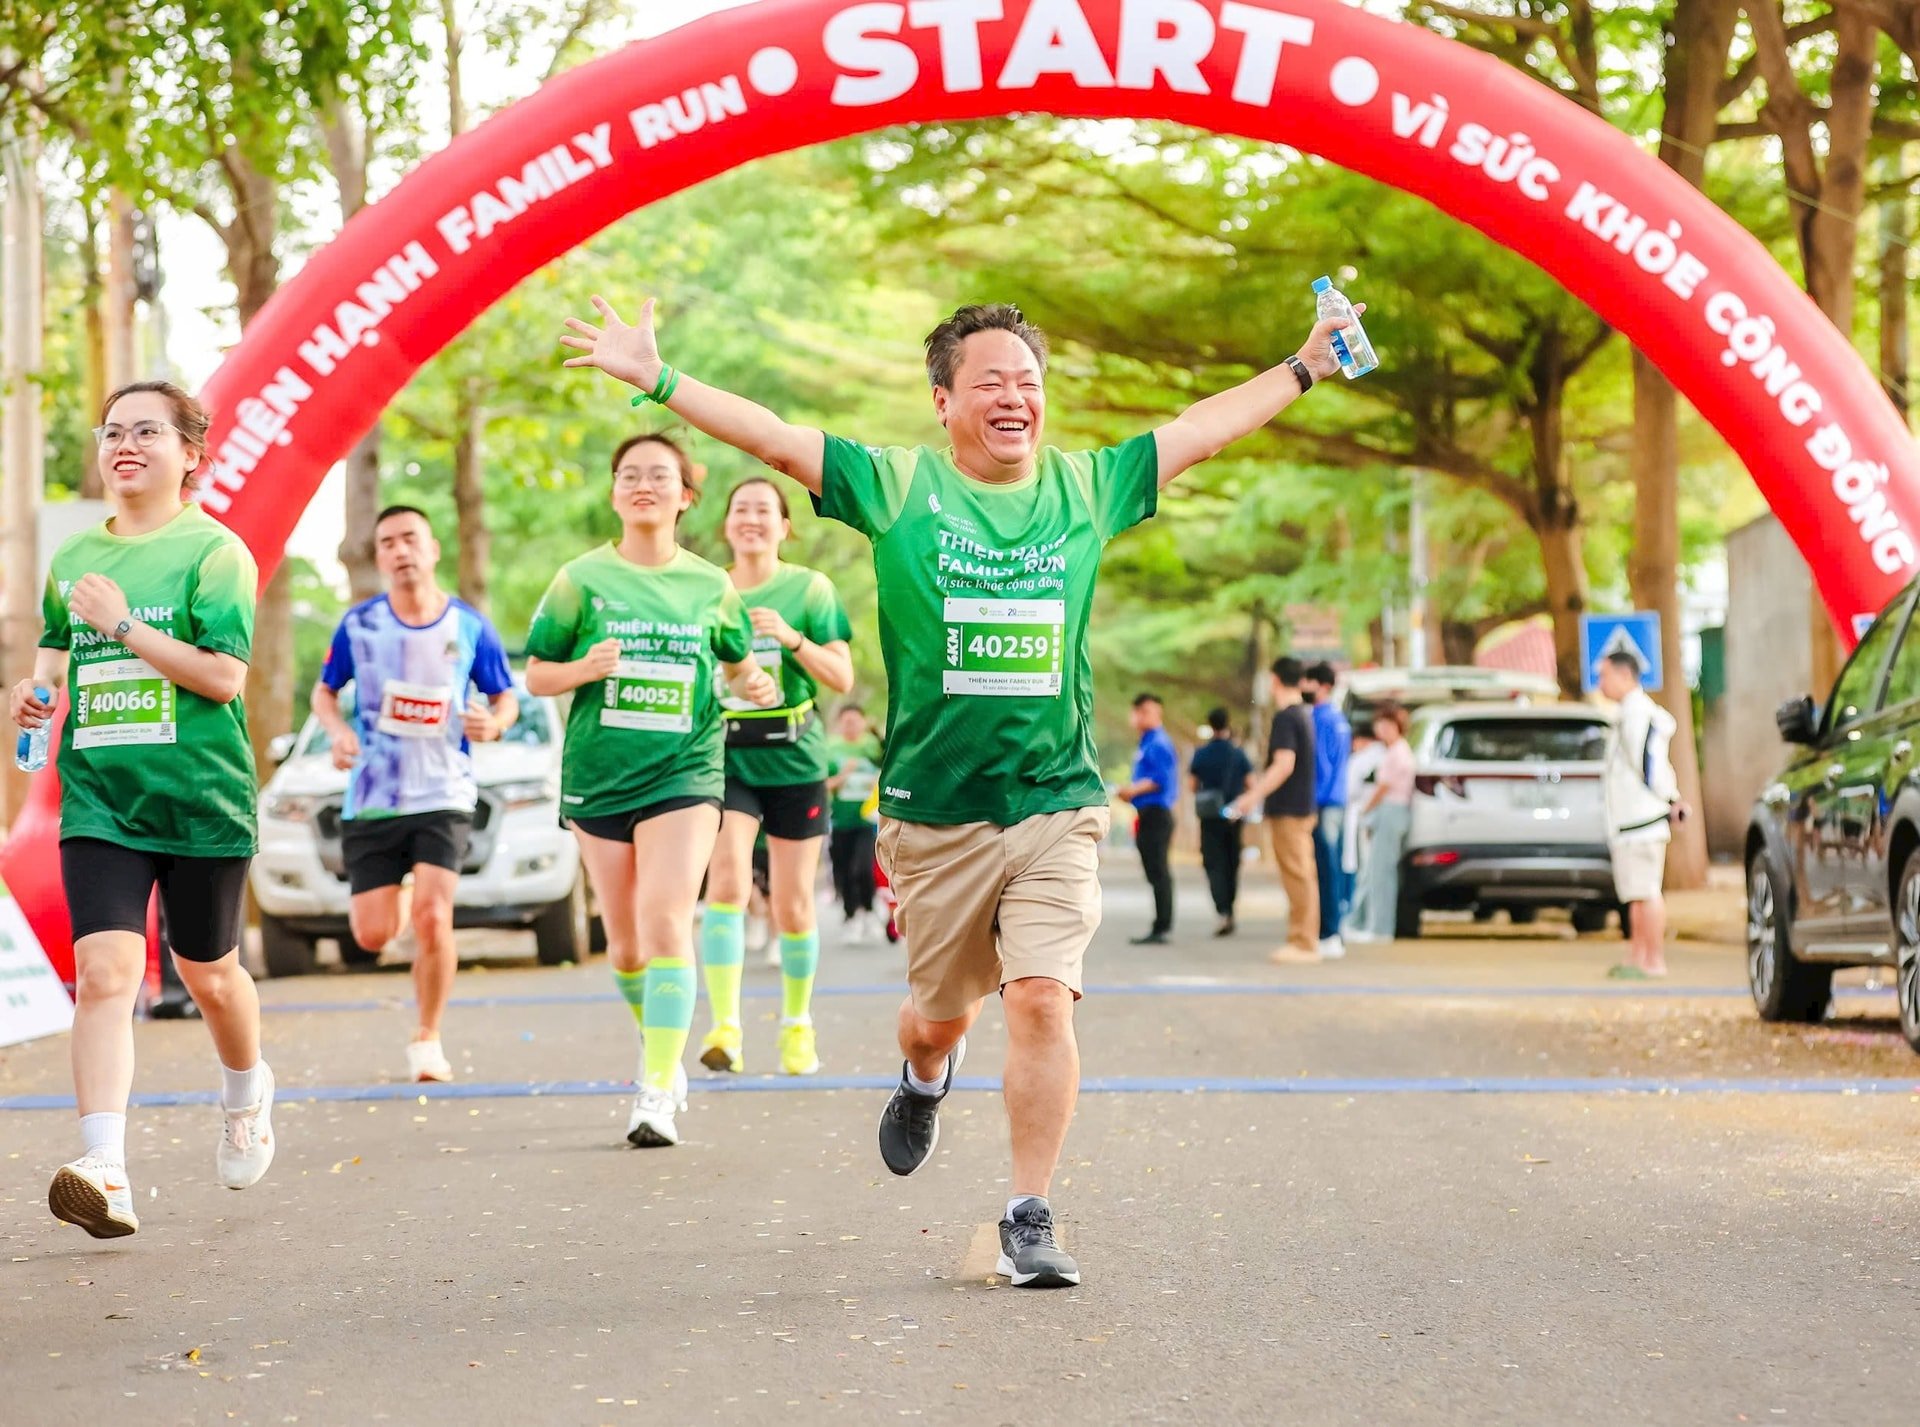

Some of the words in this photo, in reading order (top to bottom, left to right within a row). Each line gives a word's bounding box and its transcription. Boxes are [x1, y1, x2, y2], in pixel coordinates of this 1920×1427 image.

[822, 0, 1314, 107] START
[196, 366, 313, 514] THIỆN
[297, 240, 440, 377] HẠNH
[436, 122, 613, 255] FAMILY
[628, 74, 747, 149] RUN
[1391, 91, 1449, 148] VÌ
[1449, 122, 1561, 201] SỨC
[1564, 180, 1709, 300] KHỎE
[1704, 291, 1822, 426] CỘNG
[1805, 422, 1915, 575] ĐỒNG
[1024, 554, 1066, 574] RUN
[618, 638, 664, 652] AMILY
[667, 640, 701, 655] RUN
[947, 627, 959, 667] 4KM
[968, 635, 1048, 658] 40259
[77, 691, 87, 724] 4KM
[91, 690, 157, 713] 40066
[620, 685, 680, 706] 40052
